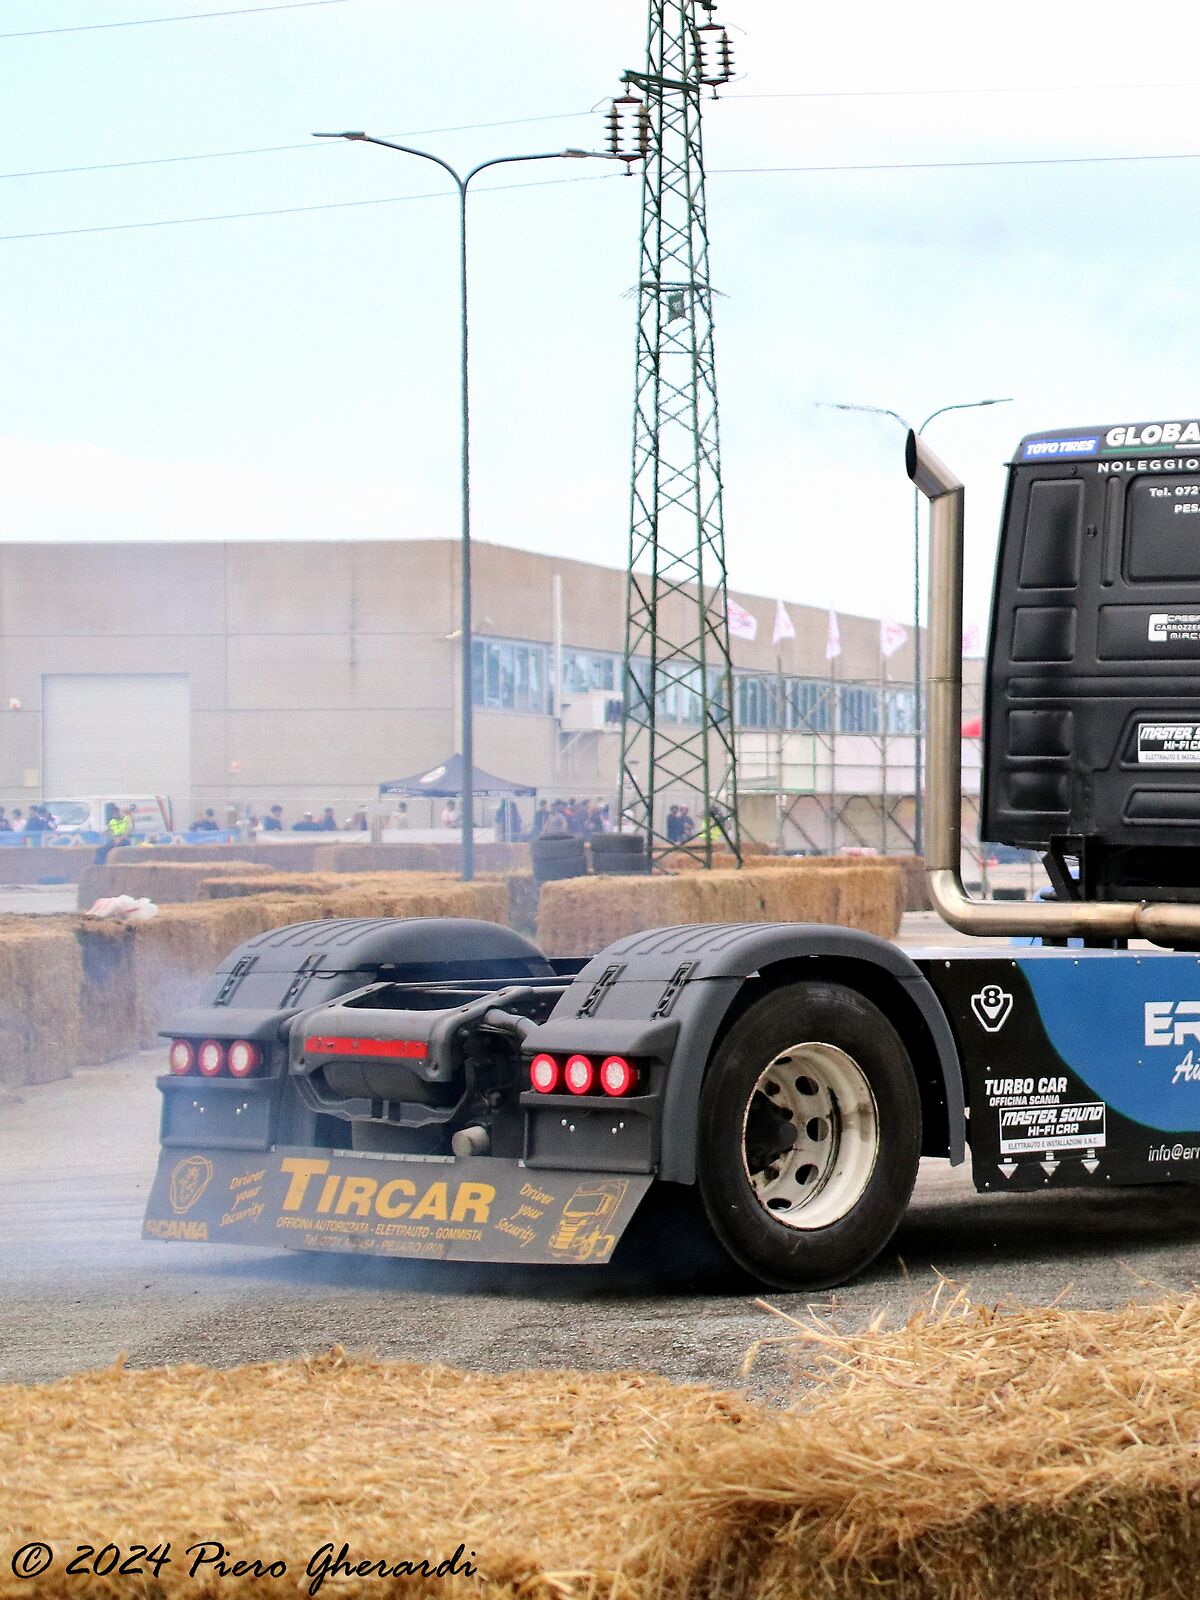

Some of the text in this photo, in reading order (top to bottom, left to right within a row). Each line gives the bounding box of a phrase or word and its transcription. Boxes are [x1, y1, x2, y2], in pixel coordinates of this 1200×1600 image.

[1027, 440, 1096, 455] TOYO TIRES
[1097, 458, 1199, 473] NOLEGGIO
[1149, 487, 1171, 497] Tel.
[1140, 727, 1193, 740] MASTER
[1163, 741, 1190, 750] HI-FI
[984, 1077, 1068, 1096] TURBO CAR
[989, 1095, 1060, 1107] OFFICINA SCANIA
[1002, 1106, 1104, 1126] MASTER SOUND
[1027, 1123, 1079, 1137] HI-FI CAR
[280, 1157, 496, 1224] TIRCAR
[520, 1183, 555, 1205] Driver
[510, 1203, 544, 1219] your
[276, 1217, 314, 1230] OFFICINA
[374, 1224, 429, 1239] ELETTRAUTO
[435, 1227, 482, 1241] GOMMISTA
[494, 1217, 535, 1248] Security
